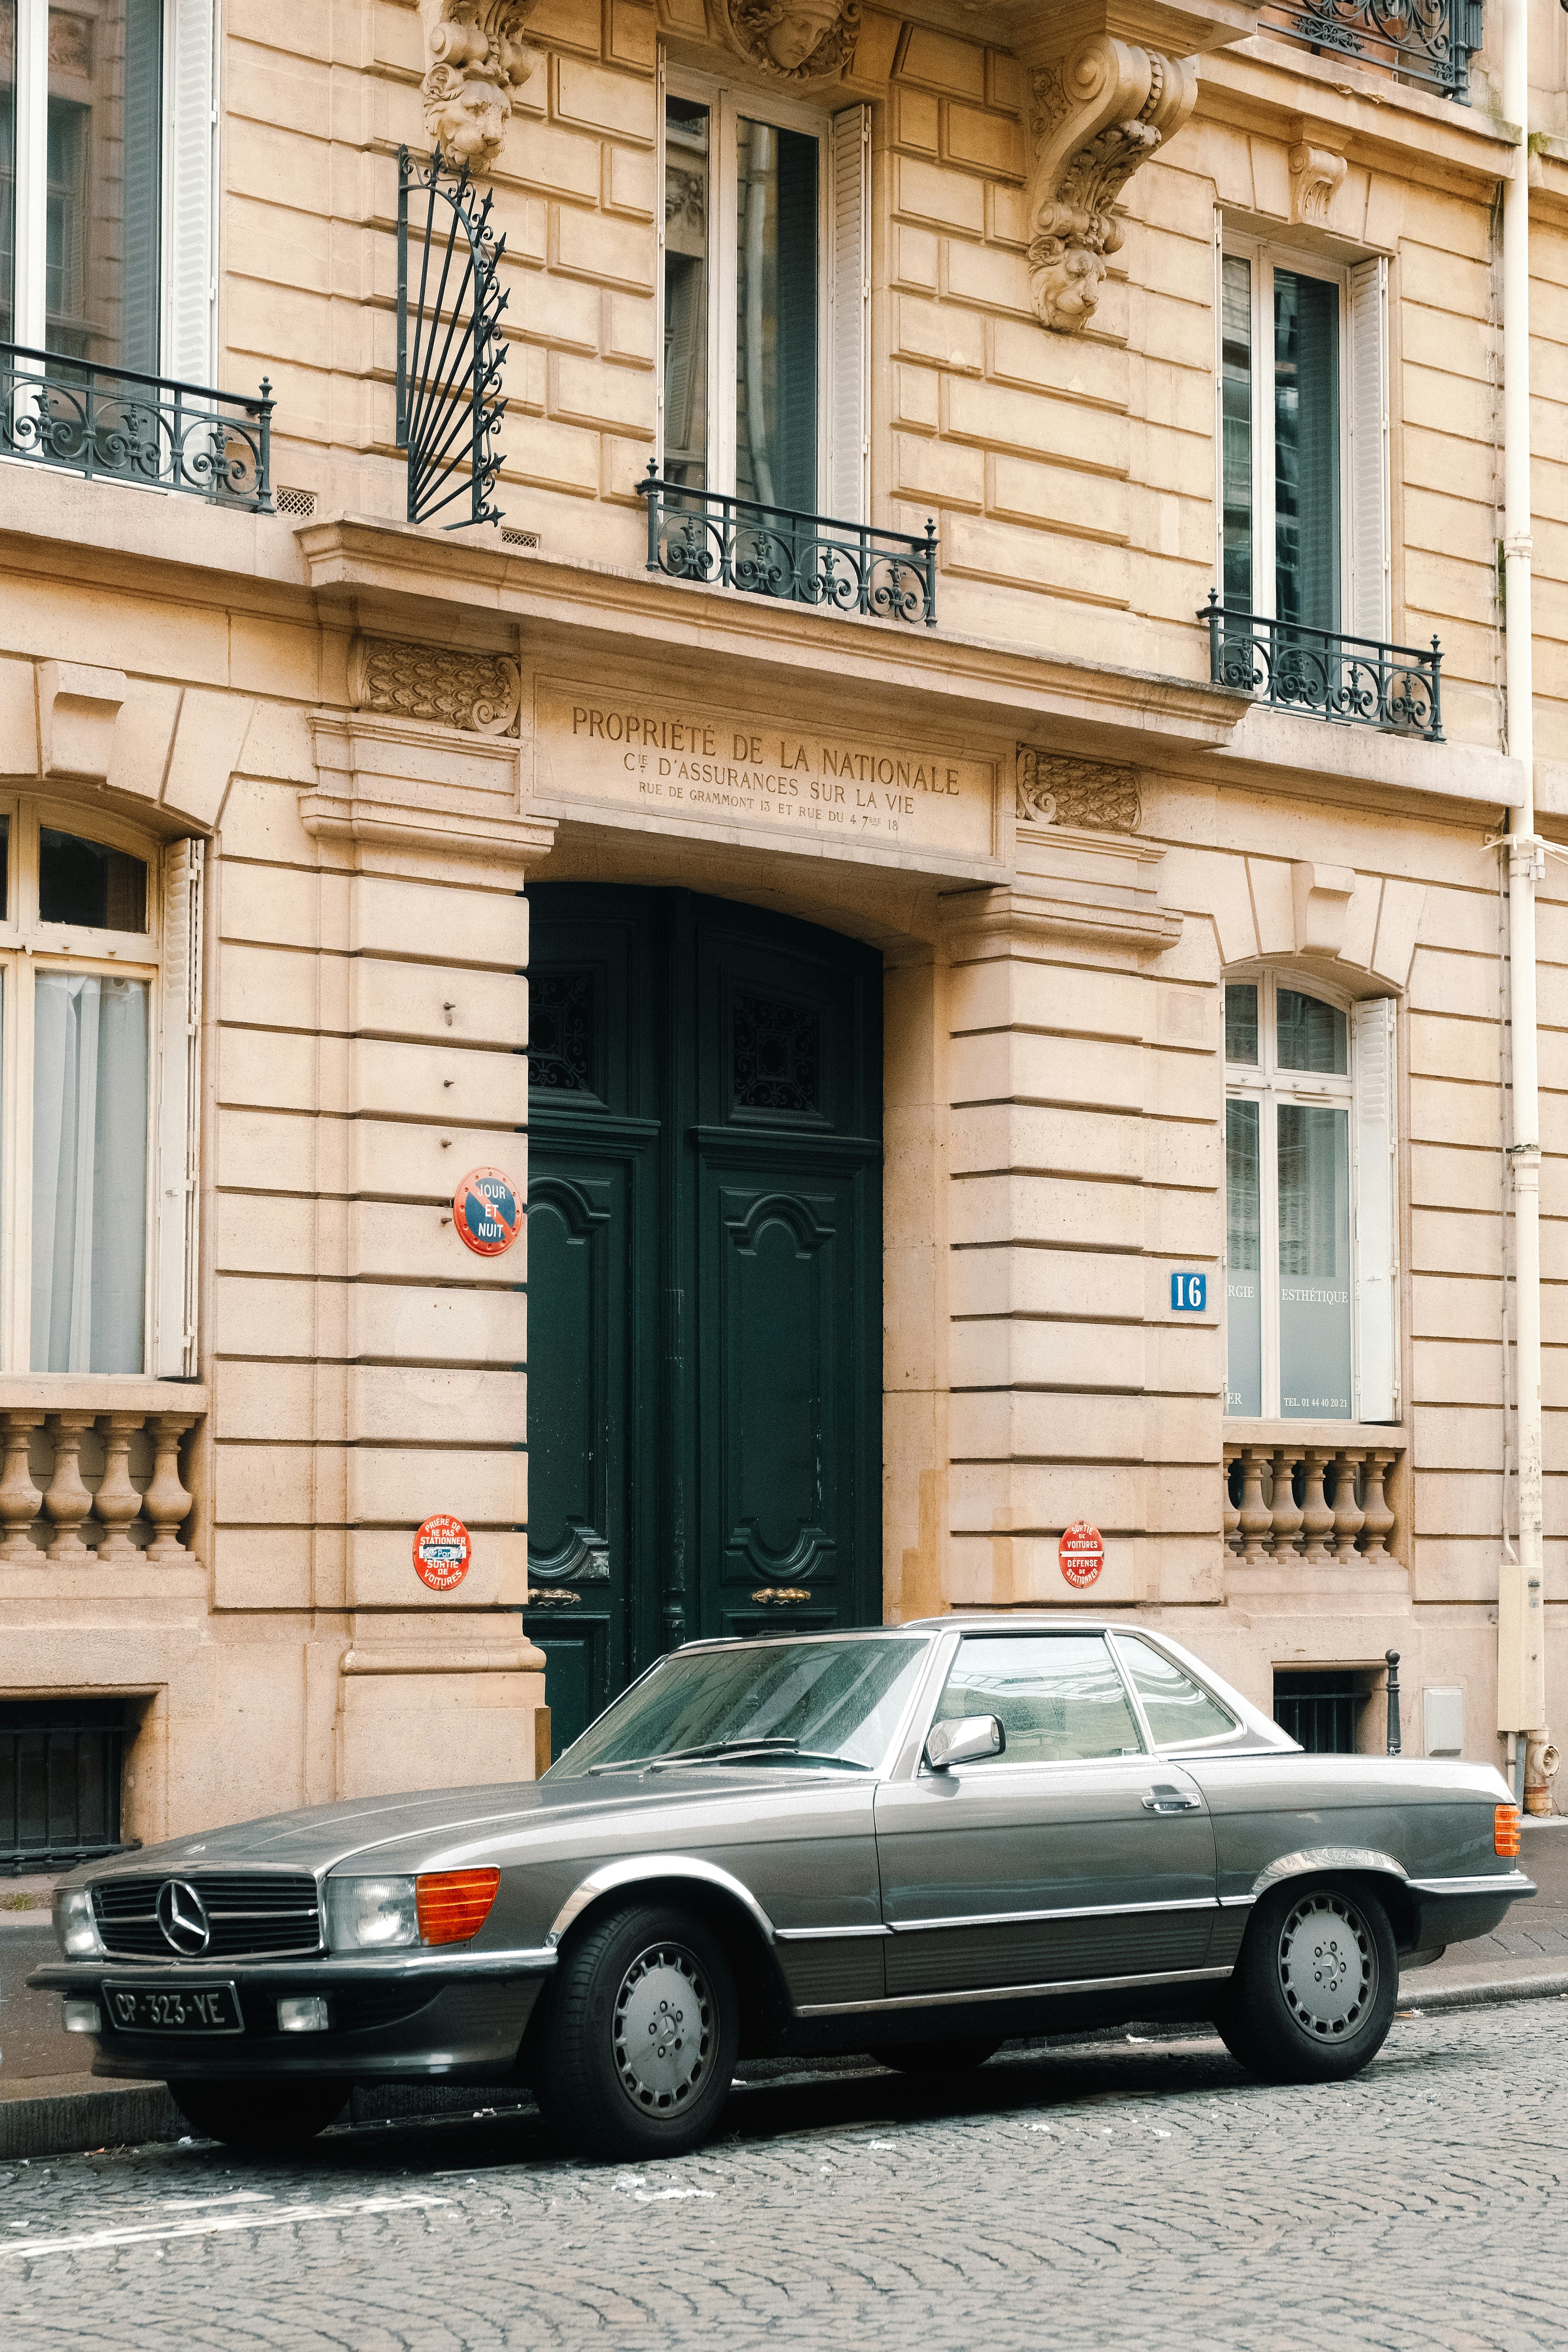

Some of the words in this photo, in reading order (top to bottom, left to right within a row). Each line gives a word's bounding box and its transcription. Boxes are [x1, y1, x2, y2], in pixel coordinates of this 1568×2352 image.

[572, 706, 716, 756] PROPRIÉTÉ
[732, 733, 763, 764] DE
[780, 741, 809, 772] LA
[823, 748, 960, 795] NATIONALE
[659, 757, 798, 796] D'ASSURANCES
[810, 781, 845, 804] SUR
[856, 788, 877, 809] LA
[885, 793, 914, 814] VIE
[639, 782, 662, 795] RUE
[669, 786, 683, 798] DE
[690, 790, 754, 809] GRAMMONT
[760, 800, 770, 812] 13
[778, 803, 793, 815] ET
[799, 806, 822, 819] RUE
[828, 811, 844, 823] DU
[850, 814, 857, 824] 4
[888, 819, 898, 831] 18
[477, 1184, 505, 1199] JOUR
[485, 1204, 499, 1218] ET
[478, 1223, 504, 1238] NUIT
[1176, 1276, 1202, 1307] 16
[1281, 1287, 1349, 1305] ESTHÉTIQUE
[1302, 1398, 1310, 1407] 01
[1311, 1398, 1319, 1407] 44
[1321, 1398, 1329, 1407] 40
[1330, 1399, 1339, 1407] 20
[1340, 1399, 1348, 1407] 21
[451, 1521, 461, 1532] DE
[1071, 1524, 1094, 1535] SORTIE
[420, 1537, 466, 1545] STATIONNER
[1067, 1541, 1098, 1549] VOITURES
[427, 1560, 459, 1568] SORTIE
[1067, 1558, 1098, 1567] DÉFENSE
[424, 1569, 462, 1586] VOITURES
[1066, 1568, 1099, 1585] STATIONNER
